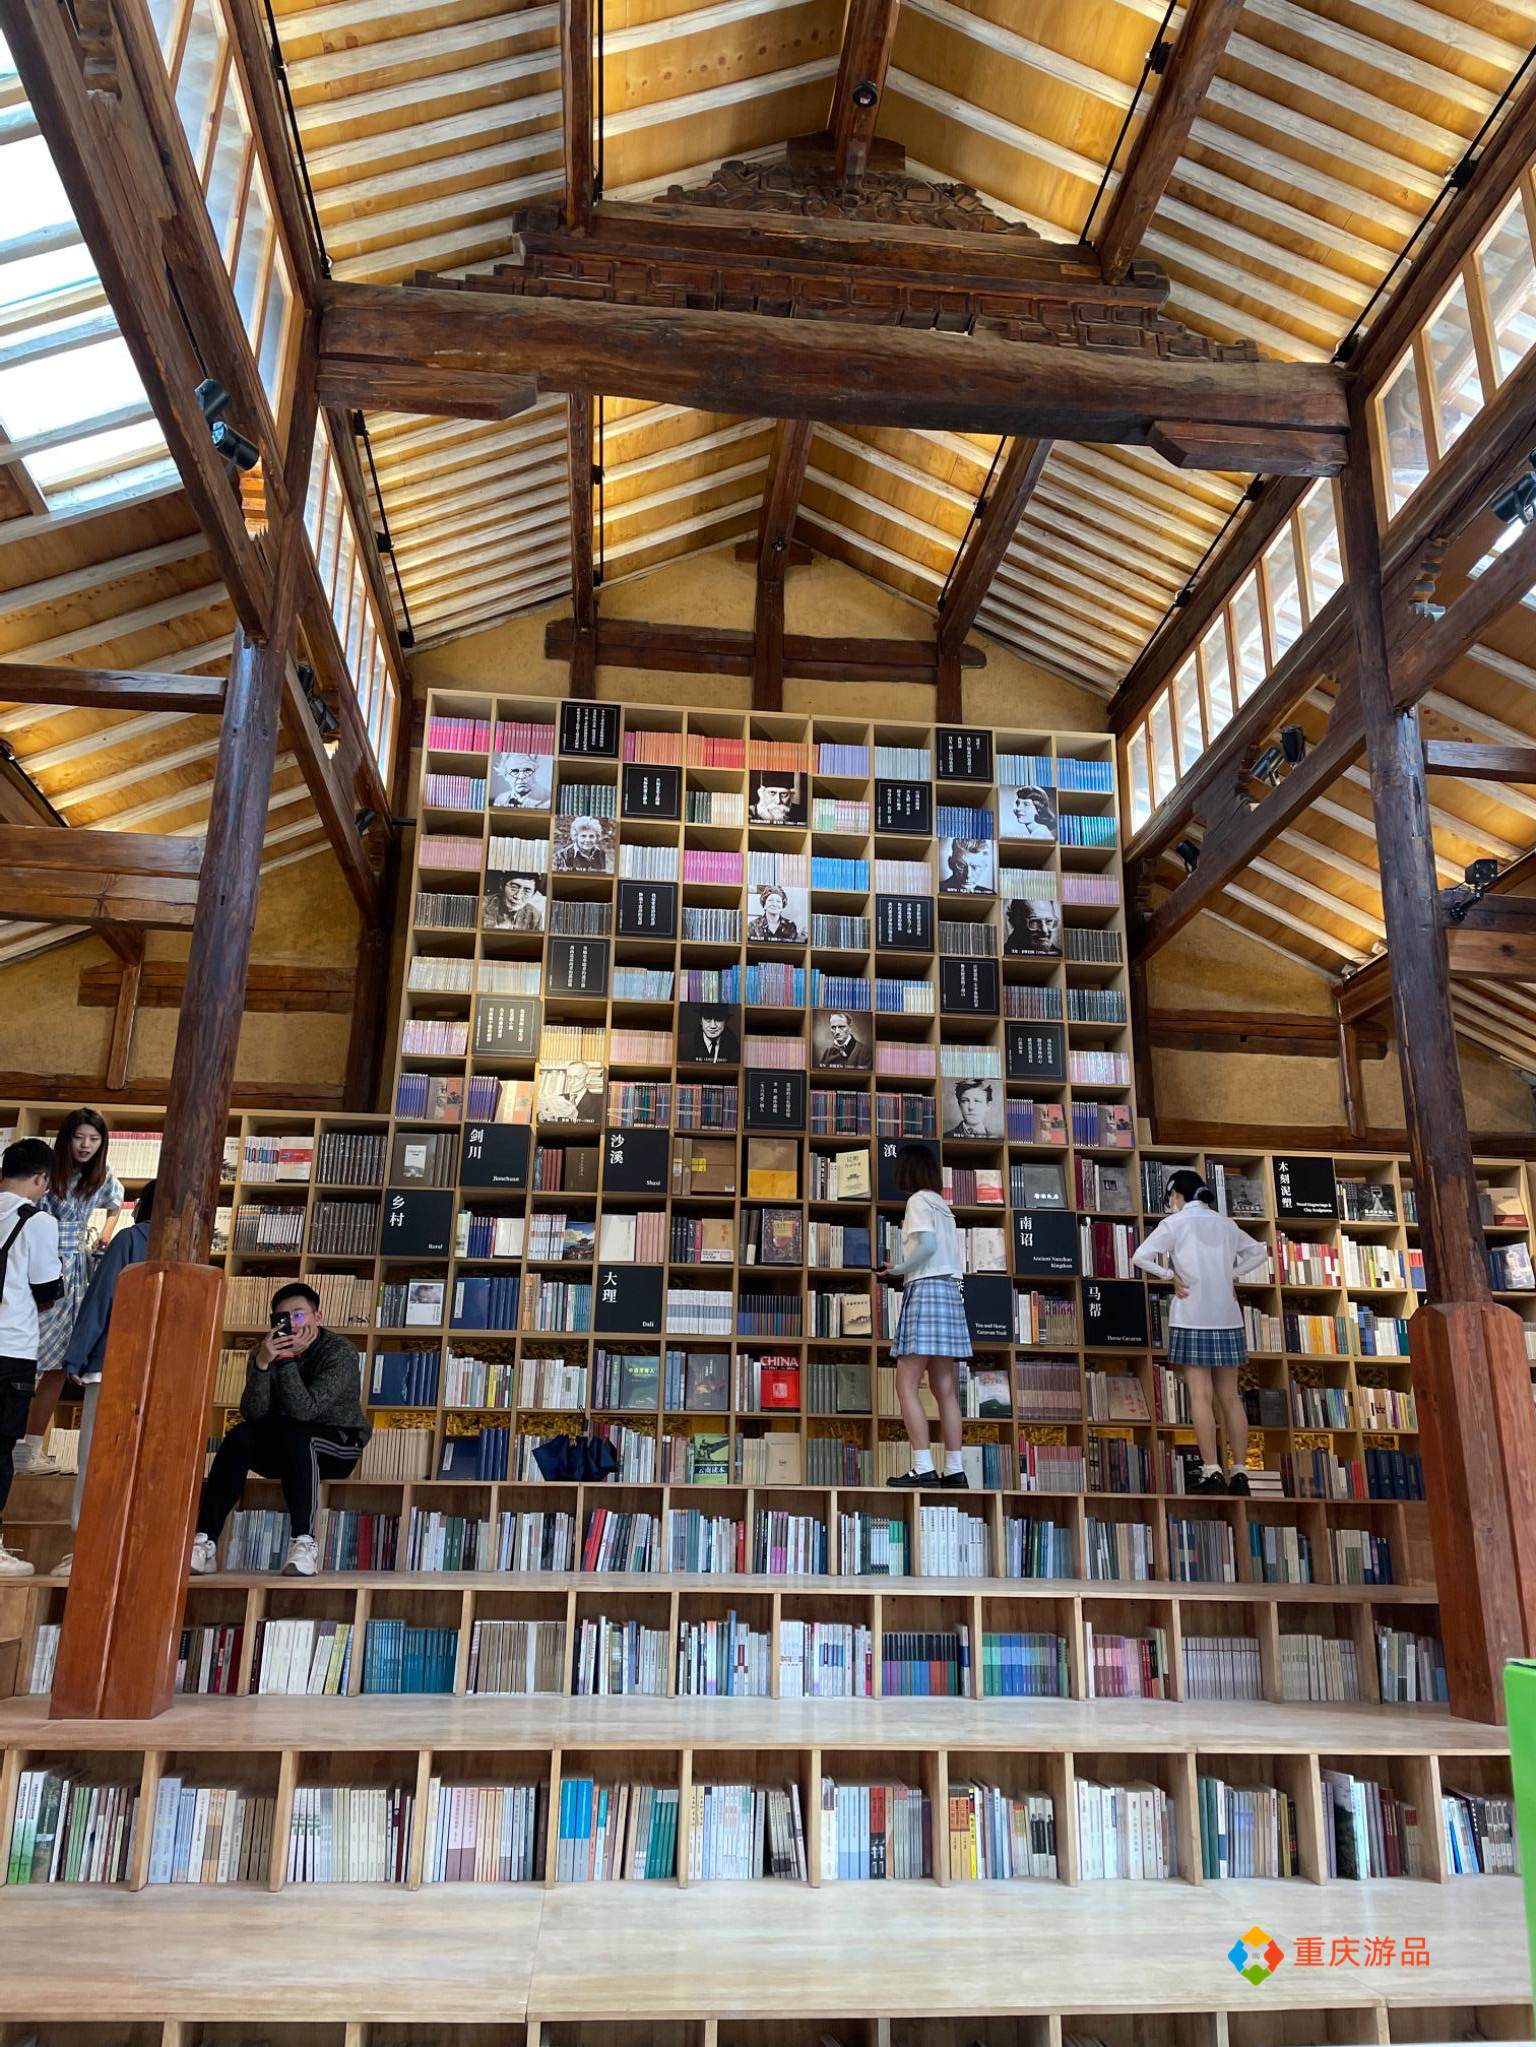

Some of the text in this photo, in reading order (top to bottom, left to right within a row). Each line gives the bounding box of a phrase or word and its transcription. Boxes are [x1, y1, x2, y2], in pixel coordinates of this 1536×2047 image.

[467, 1128, 484, 1160] 剑川
[610, 1134, 625, 1165] 沙溪
[883, 1143, 897, 1158] 滇
[1278, 1161, 1293, 1209] 木刻泥塑
[389, 1195, 405, 1227] 乡村
[1019, 1216, 1033, 1247] 南诏
[601, 1271, 618, 1303] 大理
[1088, 1286, 1102, 1318] 马帮
[760, 1355, 799, 1367] CHINA
